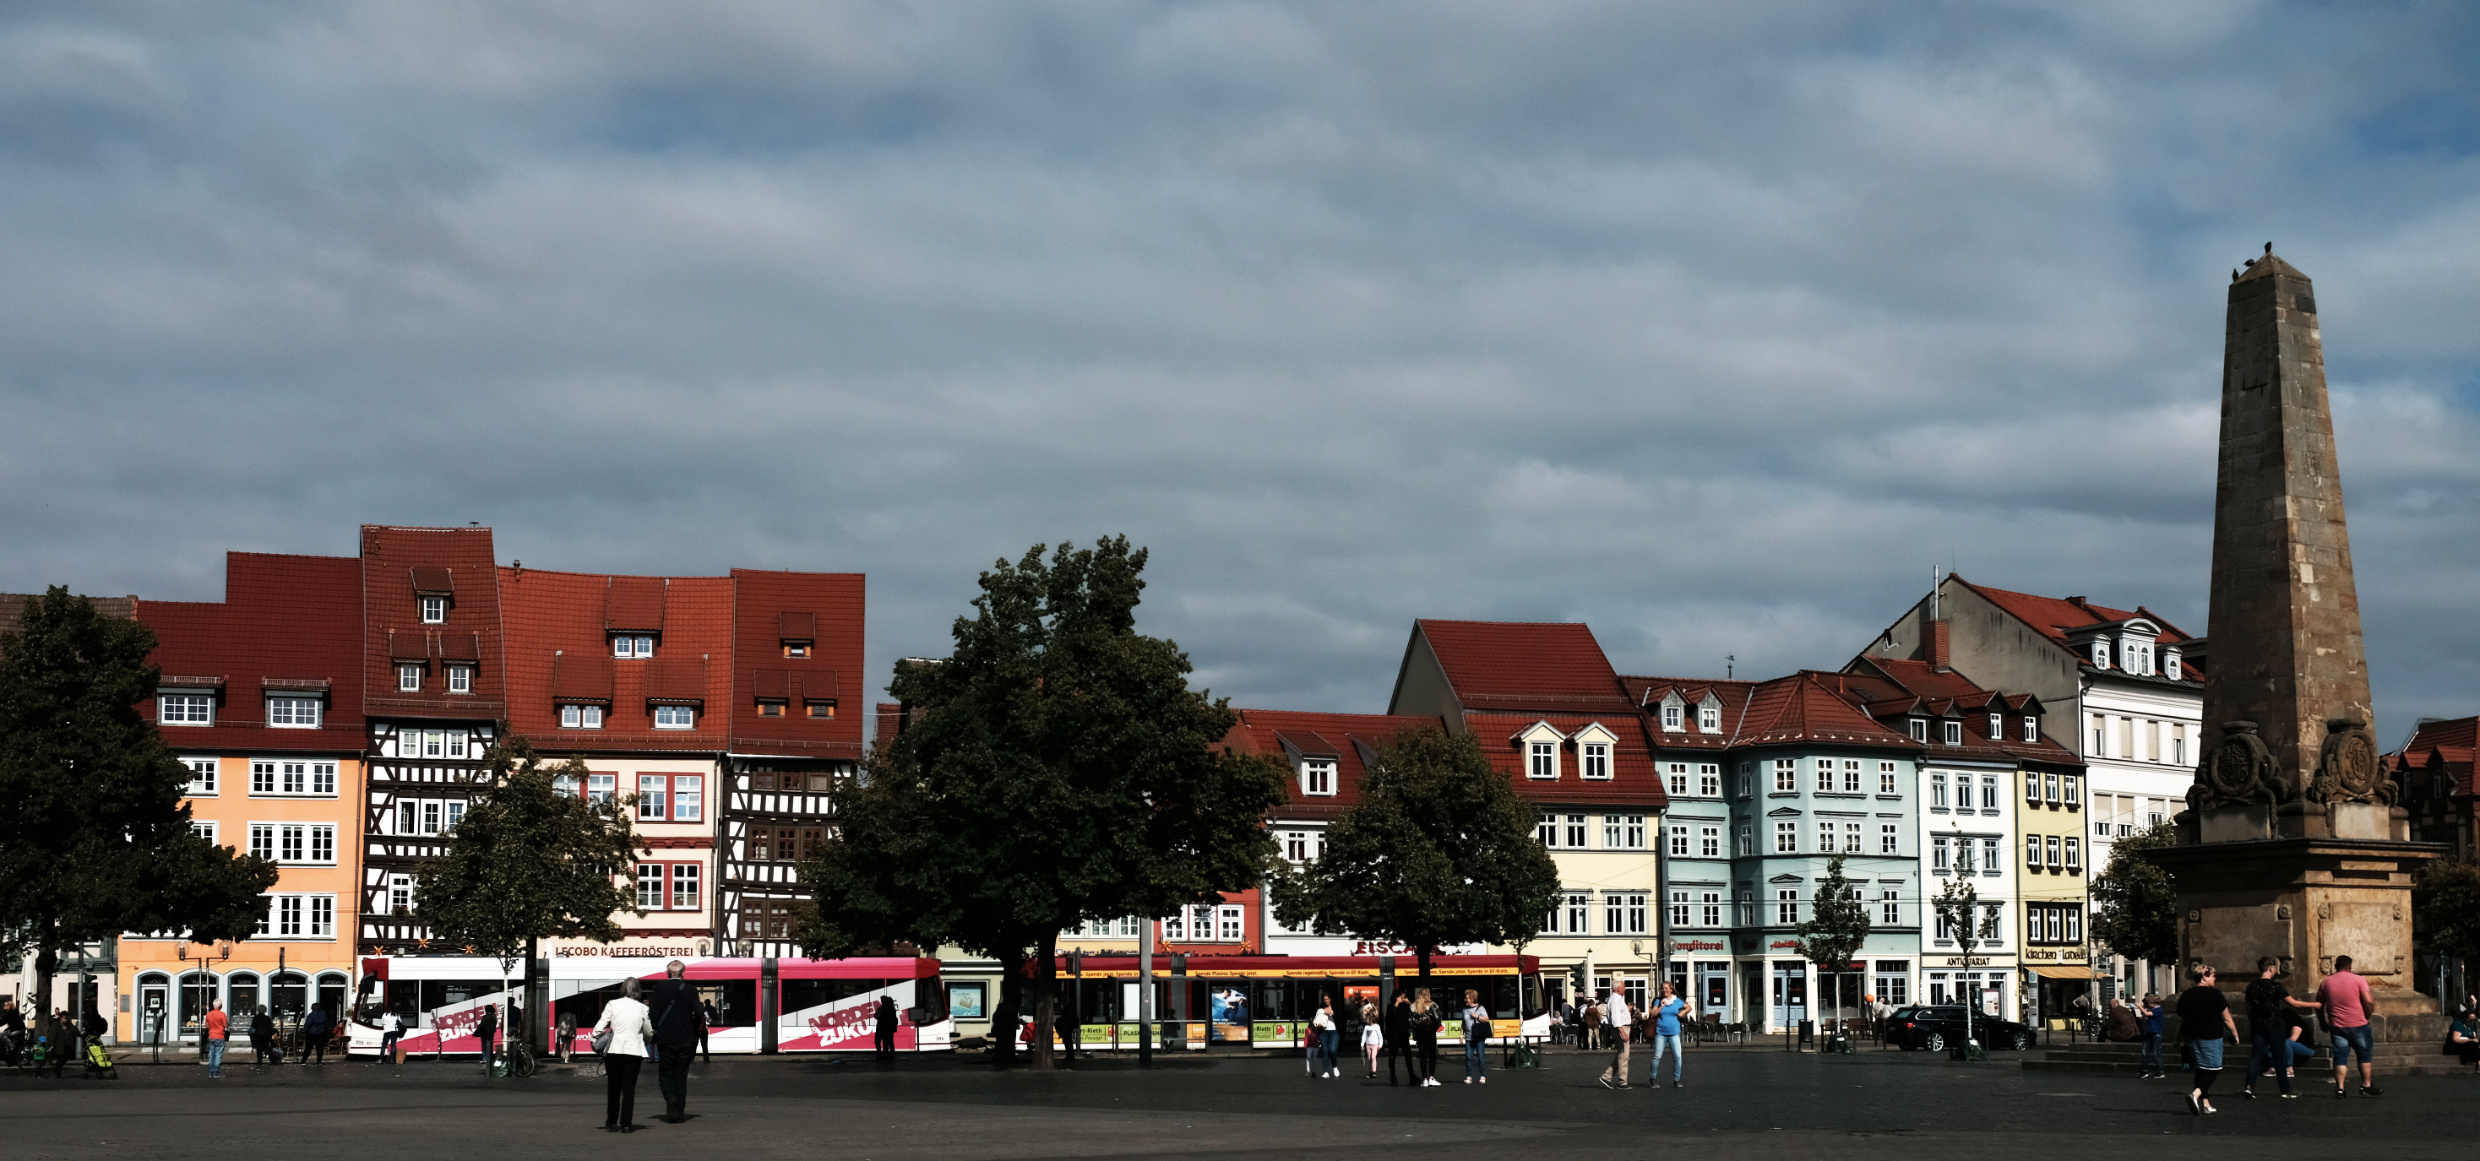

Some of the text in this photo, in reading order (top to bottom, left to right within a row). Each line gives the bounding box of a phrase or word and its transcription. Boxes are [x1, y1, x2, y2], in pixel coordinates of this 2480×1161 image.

[556, 945, 693, 957] LECOBO KAFFEERÖSTEREI
[1671, 940, 1724, 951] onditorei
[2026, 948, 2057, 959] kirchen
